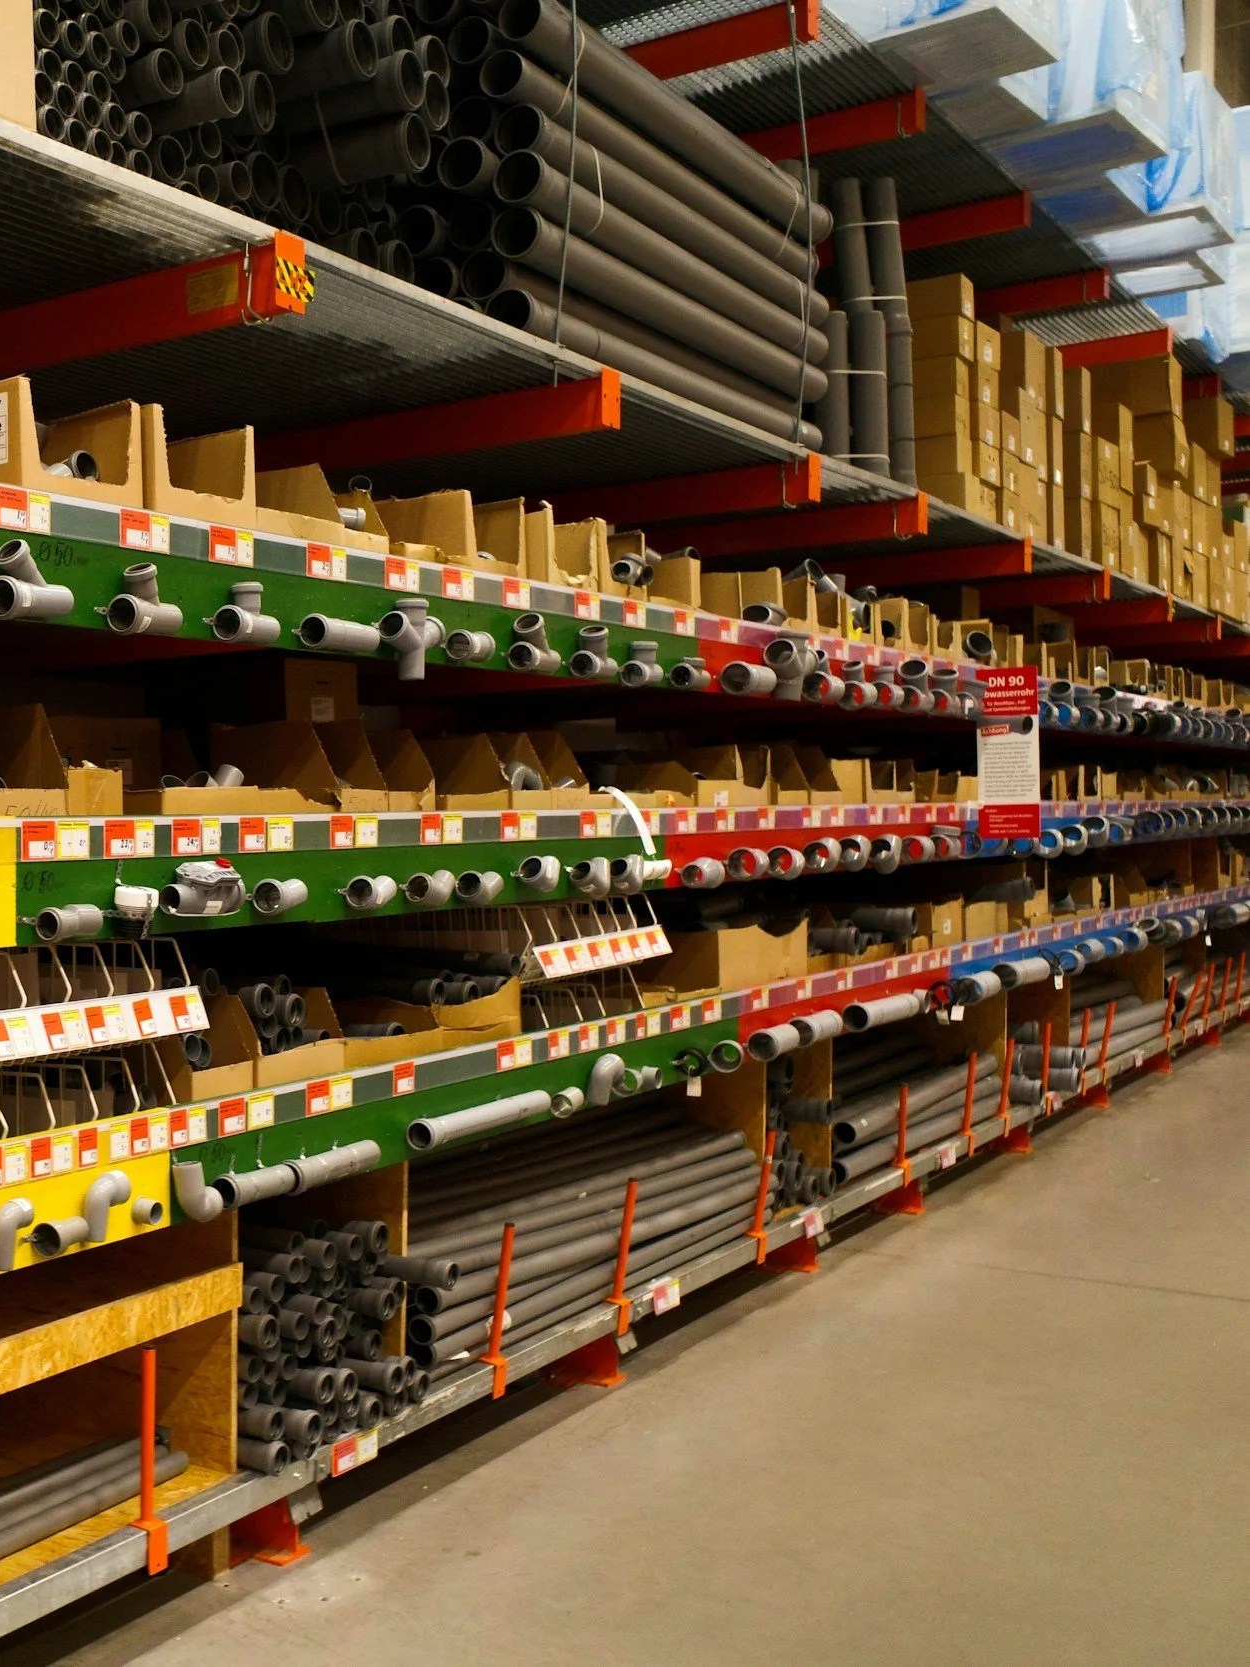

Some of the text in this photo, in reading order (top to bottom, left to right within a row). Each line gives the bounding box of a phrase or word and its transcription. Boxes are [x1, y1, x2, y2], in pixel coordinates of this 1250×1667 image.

[988, 675, 1025, 688] DN 90
[984, 687, 1035, 699] bwasserrohr
